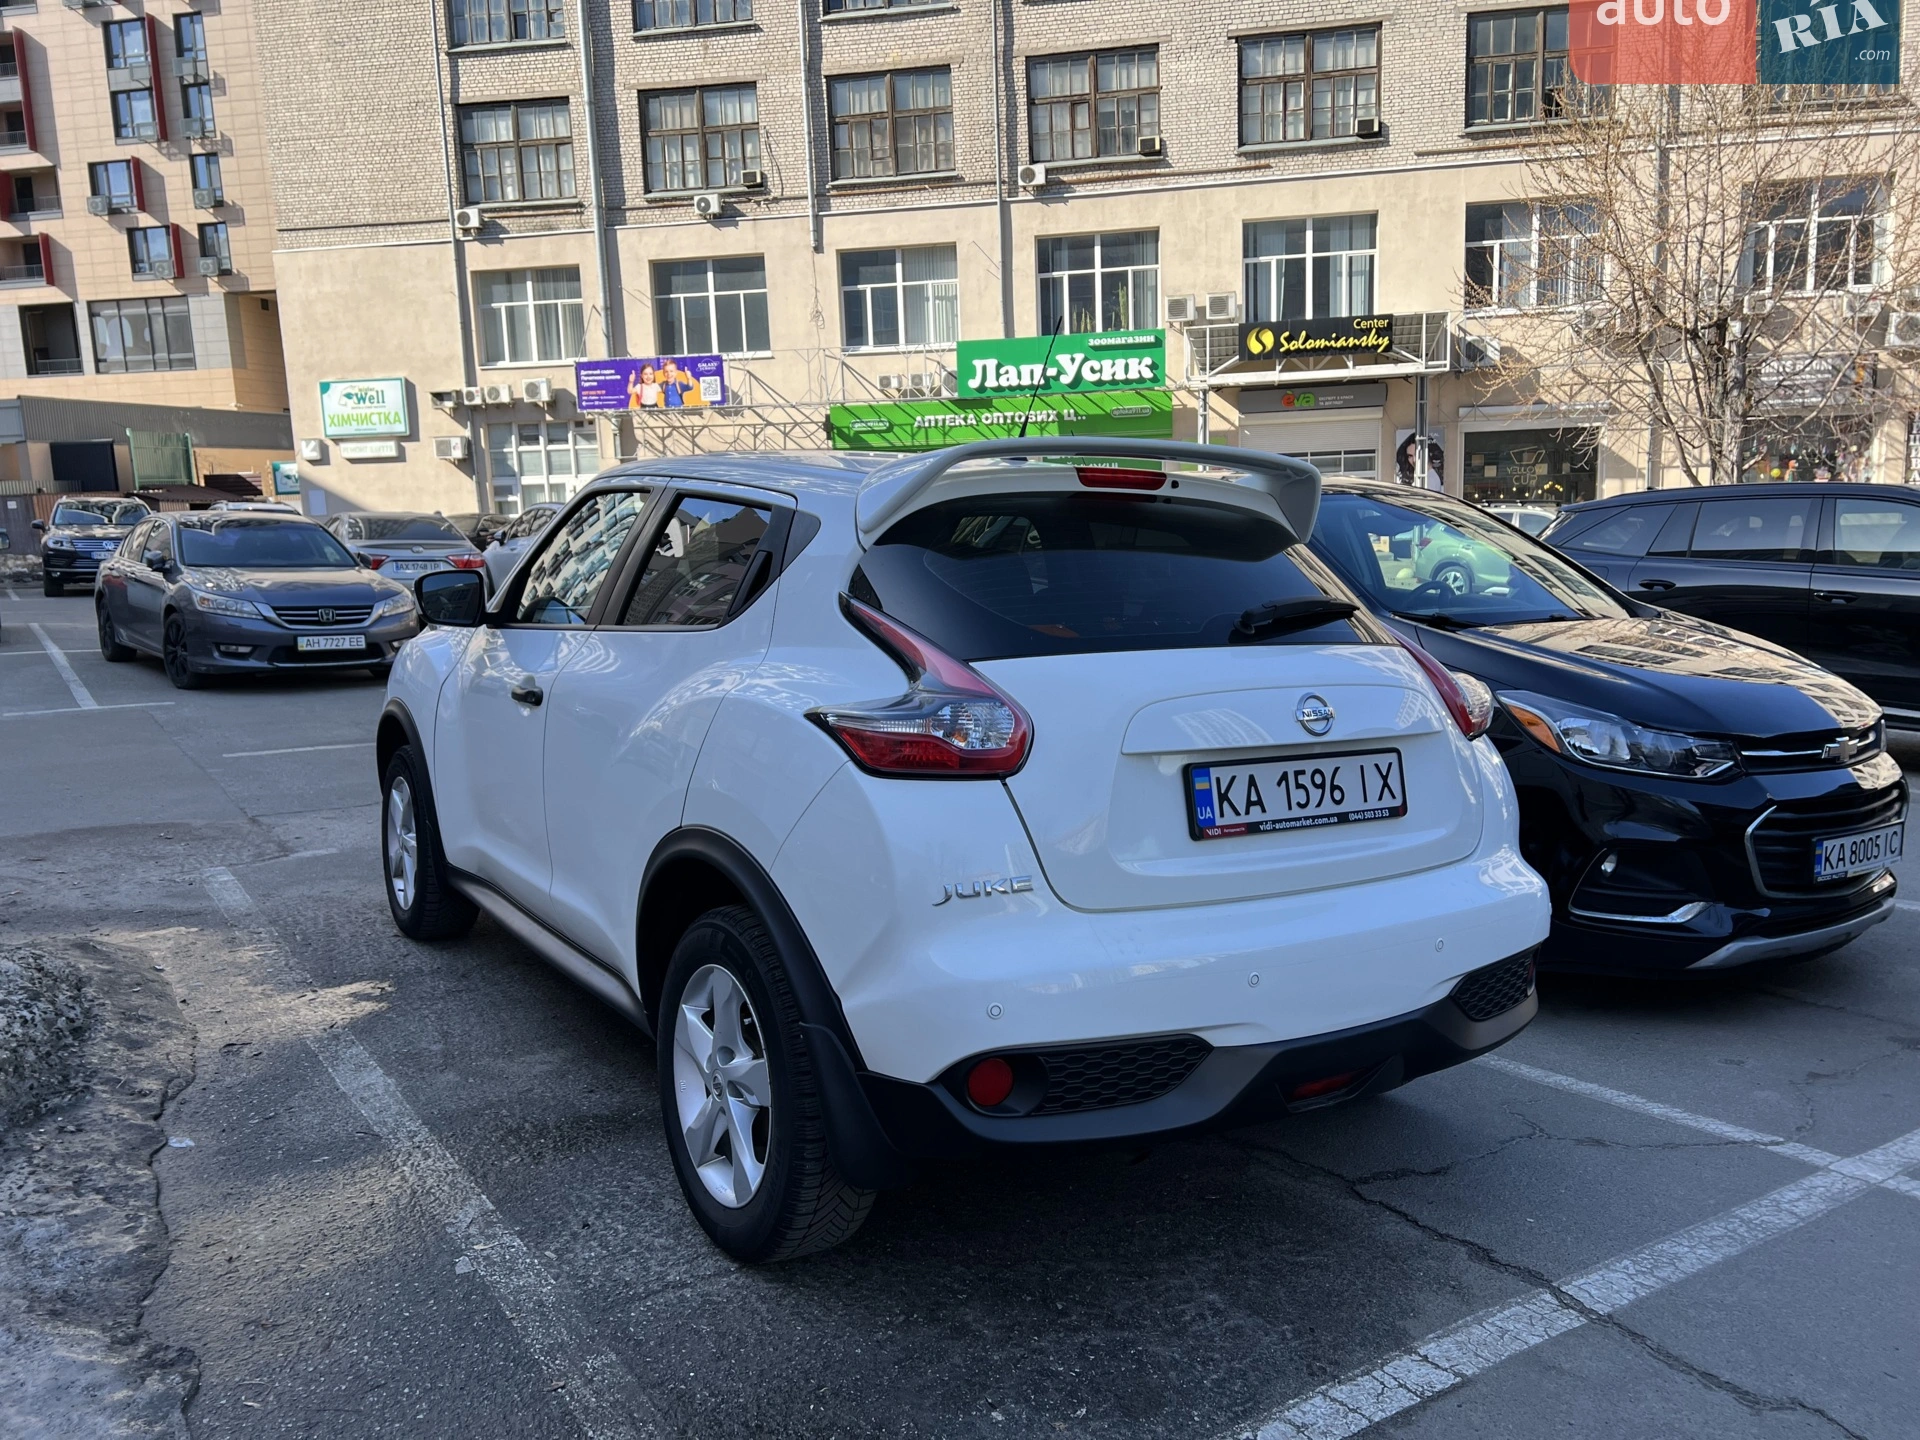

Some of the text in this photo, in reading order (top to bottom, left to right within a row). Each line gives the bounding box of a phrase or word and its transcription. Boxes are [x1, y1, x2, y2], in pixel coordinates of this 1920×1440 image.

[1353, 318, 1389, 329] Center
[1088, 335, 1156, 347] зоомагазин
[1280, 328, 1390, 353] Solomiansky
[967, 352, 1154, 389] Лап-Усик
[354, 389, 386, 405] Well
[328, 411, 402, 428] ХІМЧИСТКА
[914, 413, 977, 428] АПТЕКА
[981, 409, 1059, 425] ОПТОВИХ
[1512, 474, 1538, 486] CUP
[305, 636, 364, 648] AH 7727 EE
[1302, 708, 1334, 718] NISSAN
[1215, 762, 1397, 818] KA 1596 IX
[1198, 806, 1214, 820] UA
[1259, 808, 1390, 831] vidi-automarket.com.ua (044) 503 33 53
[1205, 827, 1222, 836] VIDI
[1823, 842, 1846, 872] KA
[1849, 834, 1881, 866] 8005
[1884, 830, 1899, 857] IC
[931, 875, 1034, 907] JUKE
